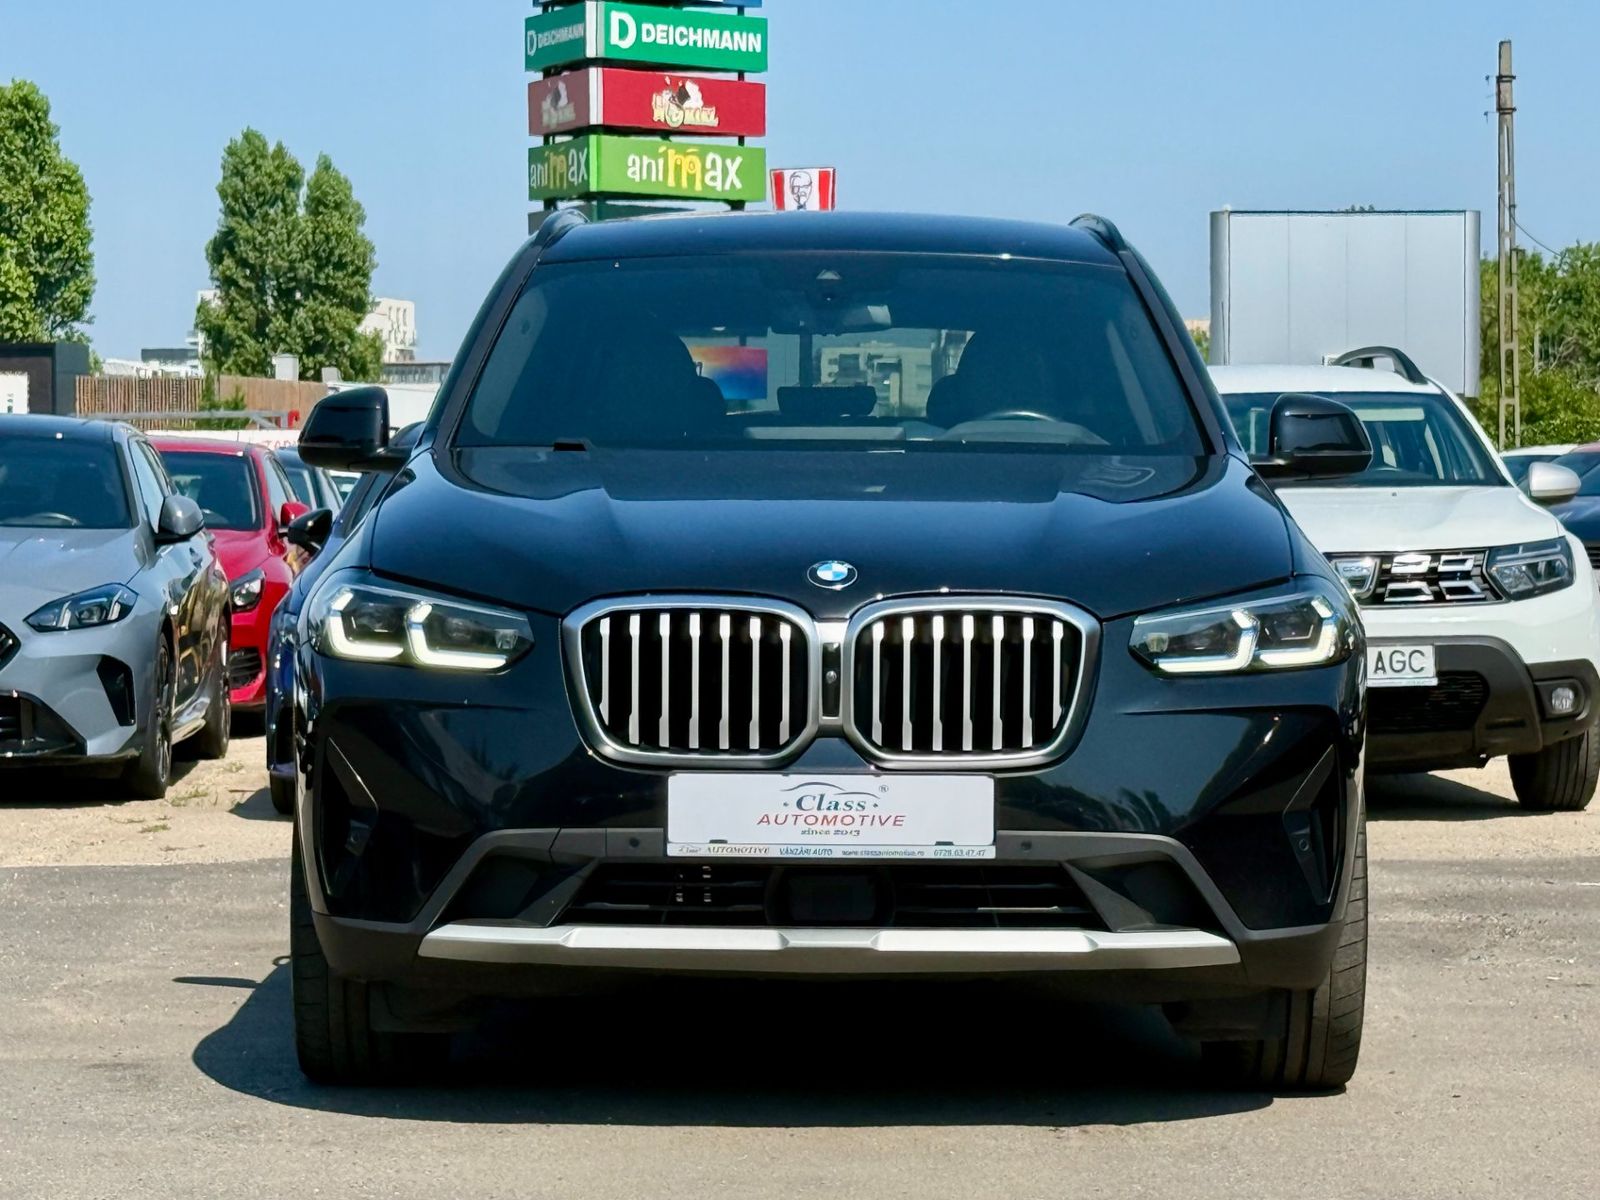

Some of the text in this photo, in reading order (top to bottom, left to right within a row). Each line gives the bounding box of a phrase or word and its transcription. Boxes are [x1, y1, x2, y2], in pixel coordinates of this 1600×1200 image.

[610, 10, 762, 53] D DEICHMANN
[530, 147, 588, 189] animax
[627, 146, 743, 192] animax
[1373, 649, 1425, 674] AGC
[796, 793, 867, 812] Class
[756, 813, 906, 827] AUTOMOTIVE
[801, 828, 830, 836] since
[812, 848, 833, 856] AUTO
